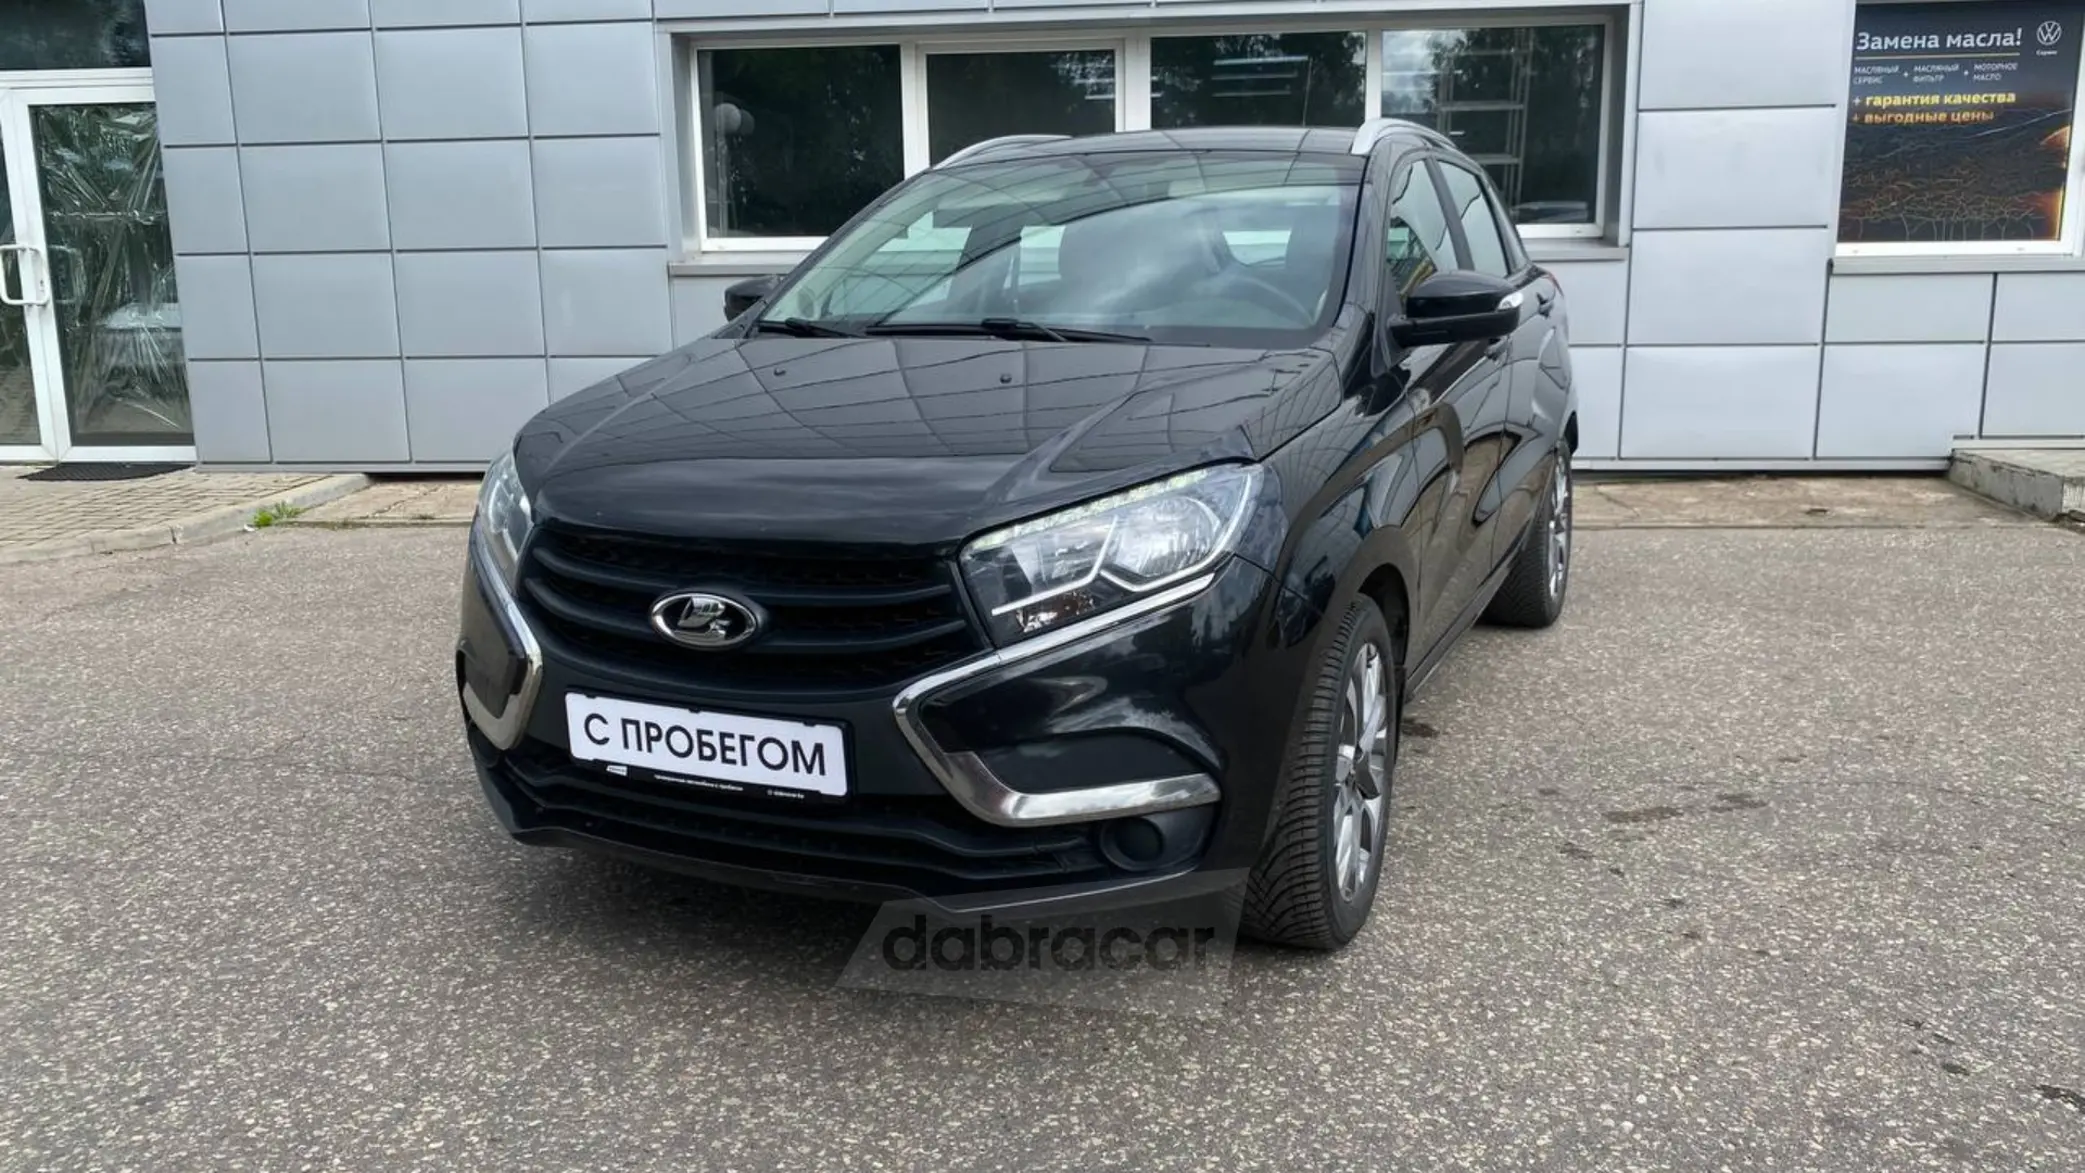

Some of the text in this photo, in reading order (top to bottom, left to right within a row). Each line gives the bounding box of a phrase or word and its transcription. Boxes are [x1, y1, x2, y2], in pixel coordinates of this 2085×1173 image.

[1856, 27, 2022, 50] Замена масла!
[1973, 73, 2001, 82] МАСЛО
[1865, 95, 1940, 109] гарантия
[1944, 91, 2016, 105] качества
[1864, 111, 1946, 124] выгодные
[1952, 110, 1995, 124] цены
[584, 713, 826, 776] С ПРОБЕГОМ
